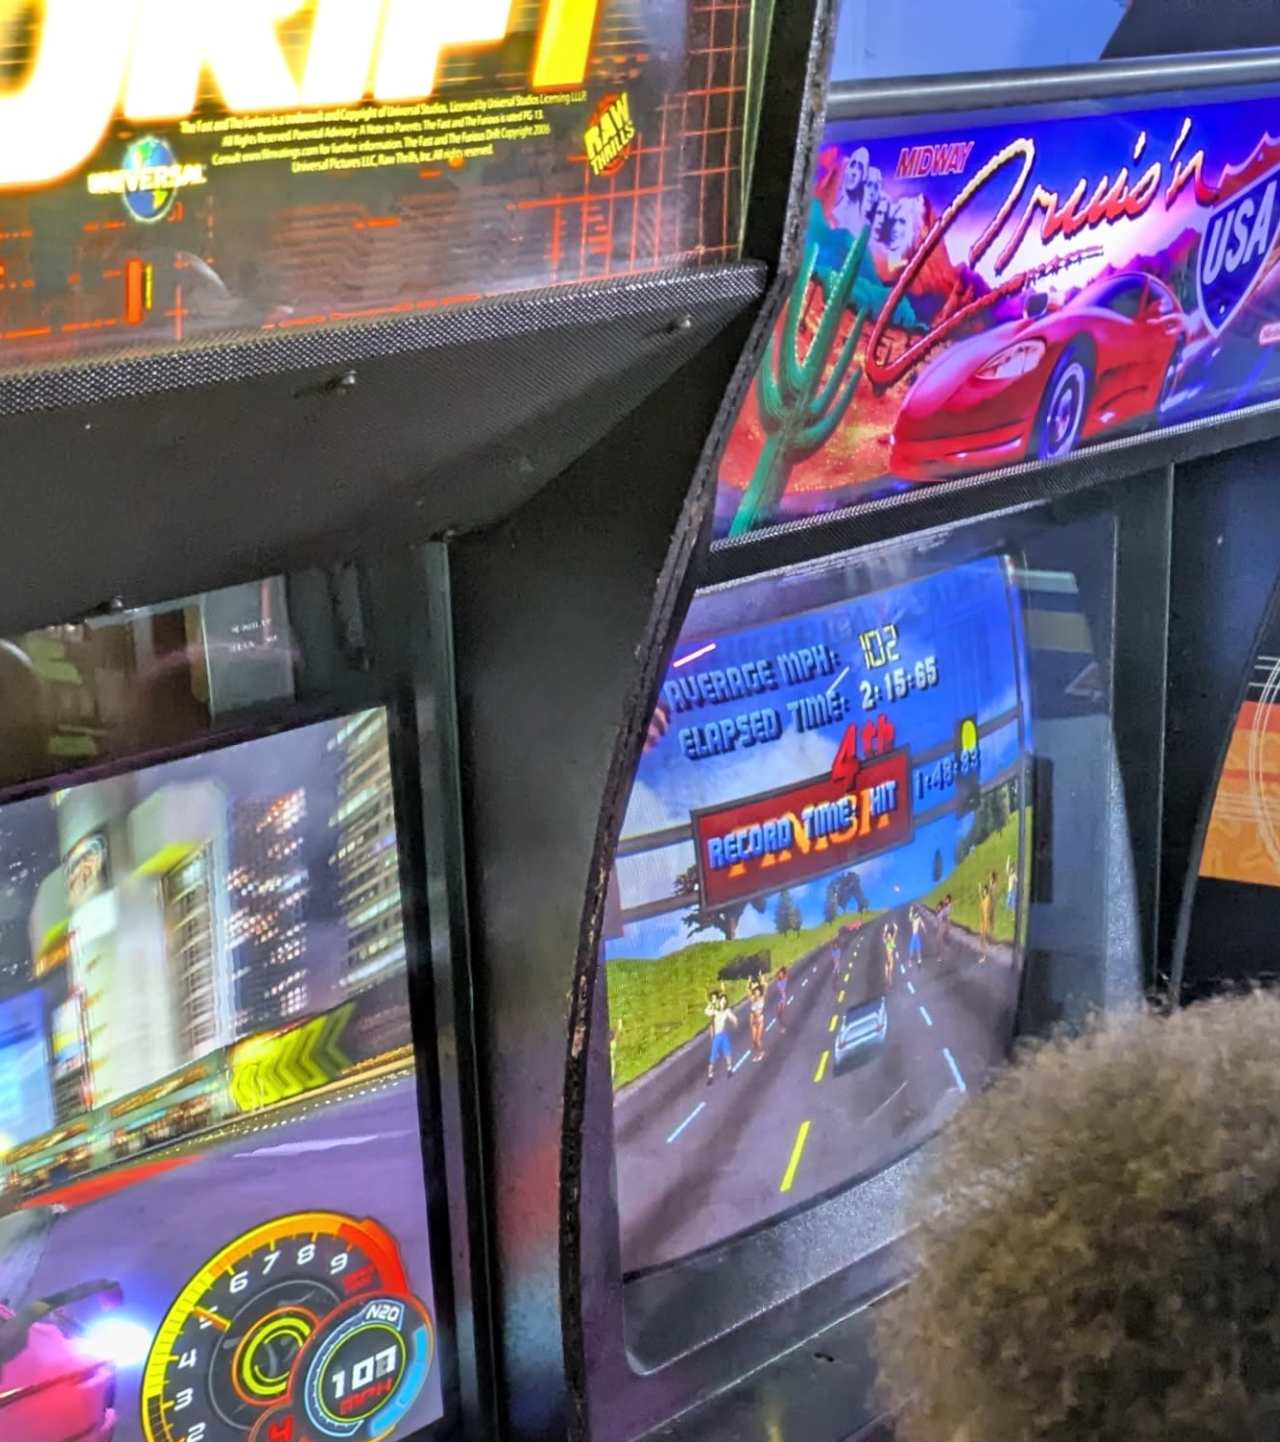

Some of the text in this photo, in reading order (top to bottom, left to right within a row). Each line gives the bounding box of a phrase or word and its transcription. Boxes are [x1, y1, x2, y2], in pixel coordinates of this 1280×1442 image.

[583, 92, 631, 160] RAW
[589, 119, 636, 176] THRILLS
[895, 141, 975, 179] MIDWAY
[87, 163, 207, 194] UNIVERSAL
[866, 116, 1212, 388] Cruis'n
[1201, 200, 1272, 286] USA
[662, 623, 899, 714] AVERAGE MPH: 102
[678, 714, 781, 761] ELAPSED
[786, 691, 850, 733] TIME:
[832, 714, 895, 793] 4th
[706, 815, 792, 871] RECORD
[802, 795, 857, 840] TIME:
[262, 1253, 281, 1276] 7
[296, 1244, 316, 1266] 8
[329, 1252, 349, 1276] 9
[229, 1270, 249, 1294] 6
[365, 1304, 402, 1323] N2O
[178, 1347, 198, 1370] 4
[173, 1388, 194, 1410] 3
